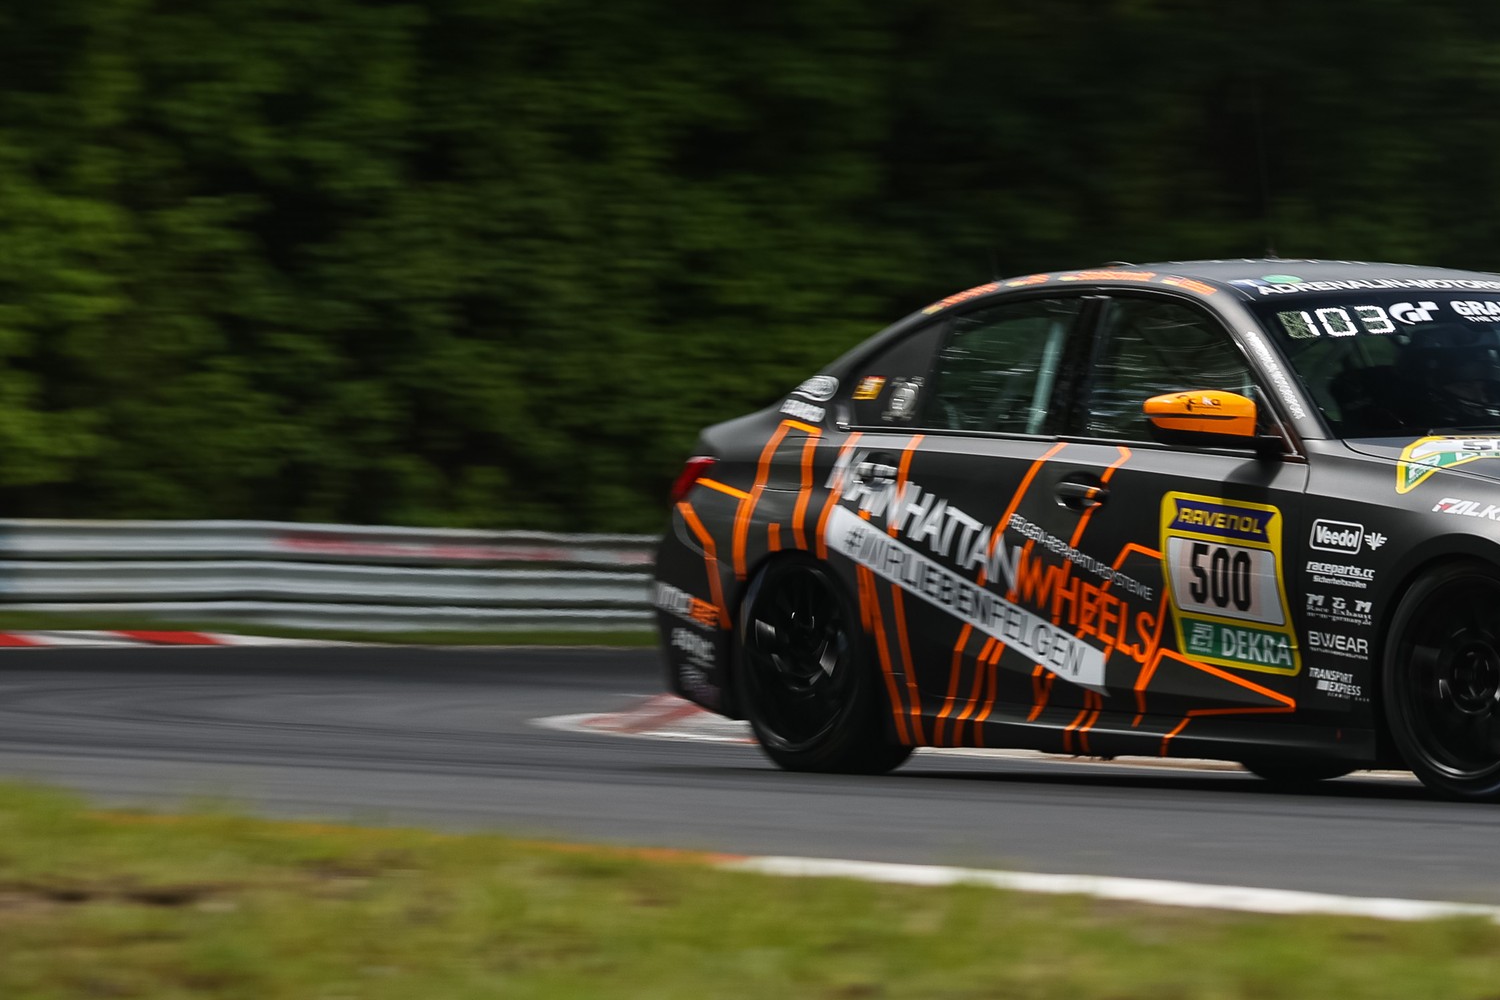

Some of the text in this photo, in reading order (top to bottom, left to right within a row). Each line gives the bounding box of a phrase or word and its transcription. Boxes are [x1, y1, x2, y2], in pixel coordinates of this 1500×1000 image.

[1178, 507, 1263, 534] RAVENOL
[1316, 525, 1360, 548] Veedol
[1189, 542, 1252, 612] 500
[1306, 560, 1376, 579] raceparts.cc
[1306, 593, 1325, 607] M
[1354, 600, 1373, 613] M
[1332, 608, 1372, 620] Exhaust
[1221, 627, 1293, 667] DEKRA
[1308, 630, 1368, 655] BWEAR
